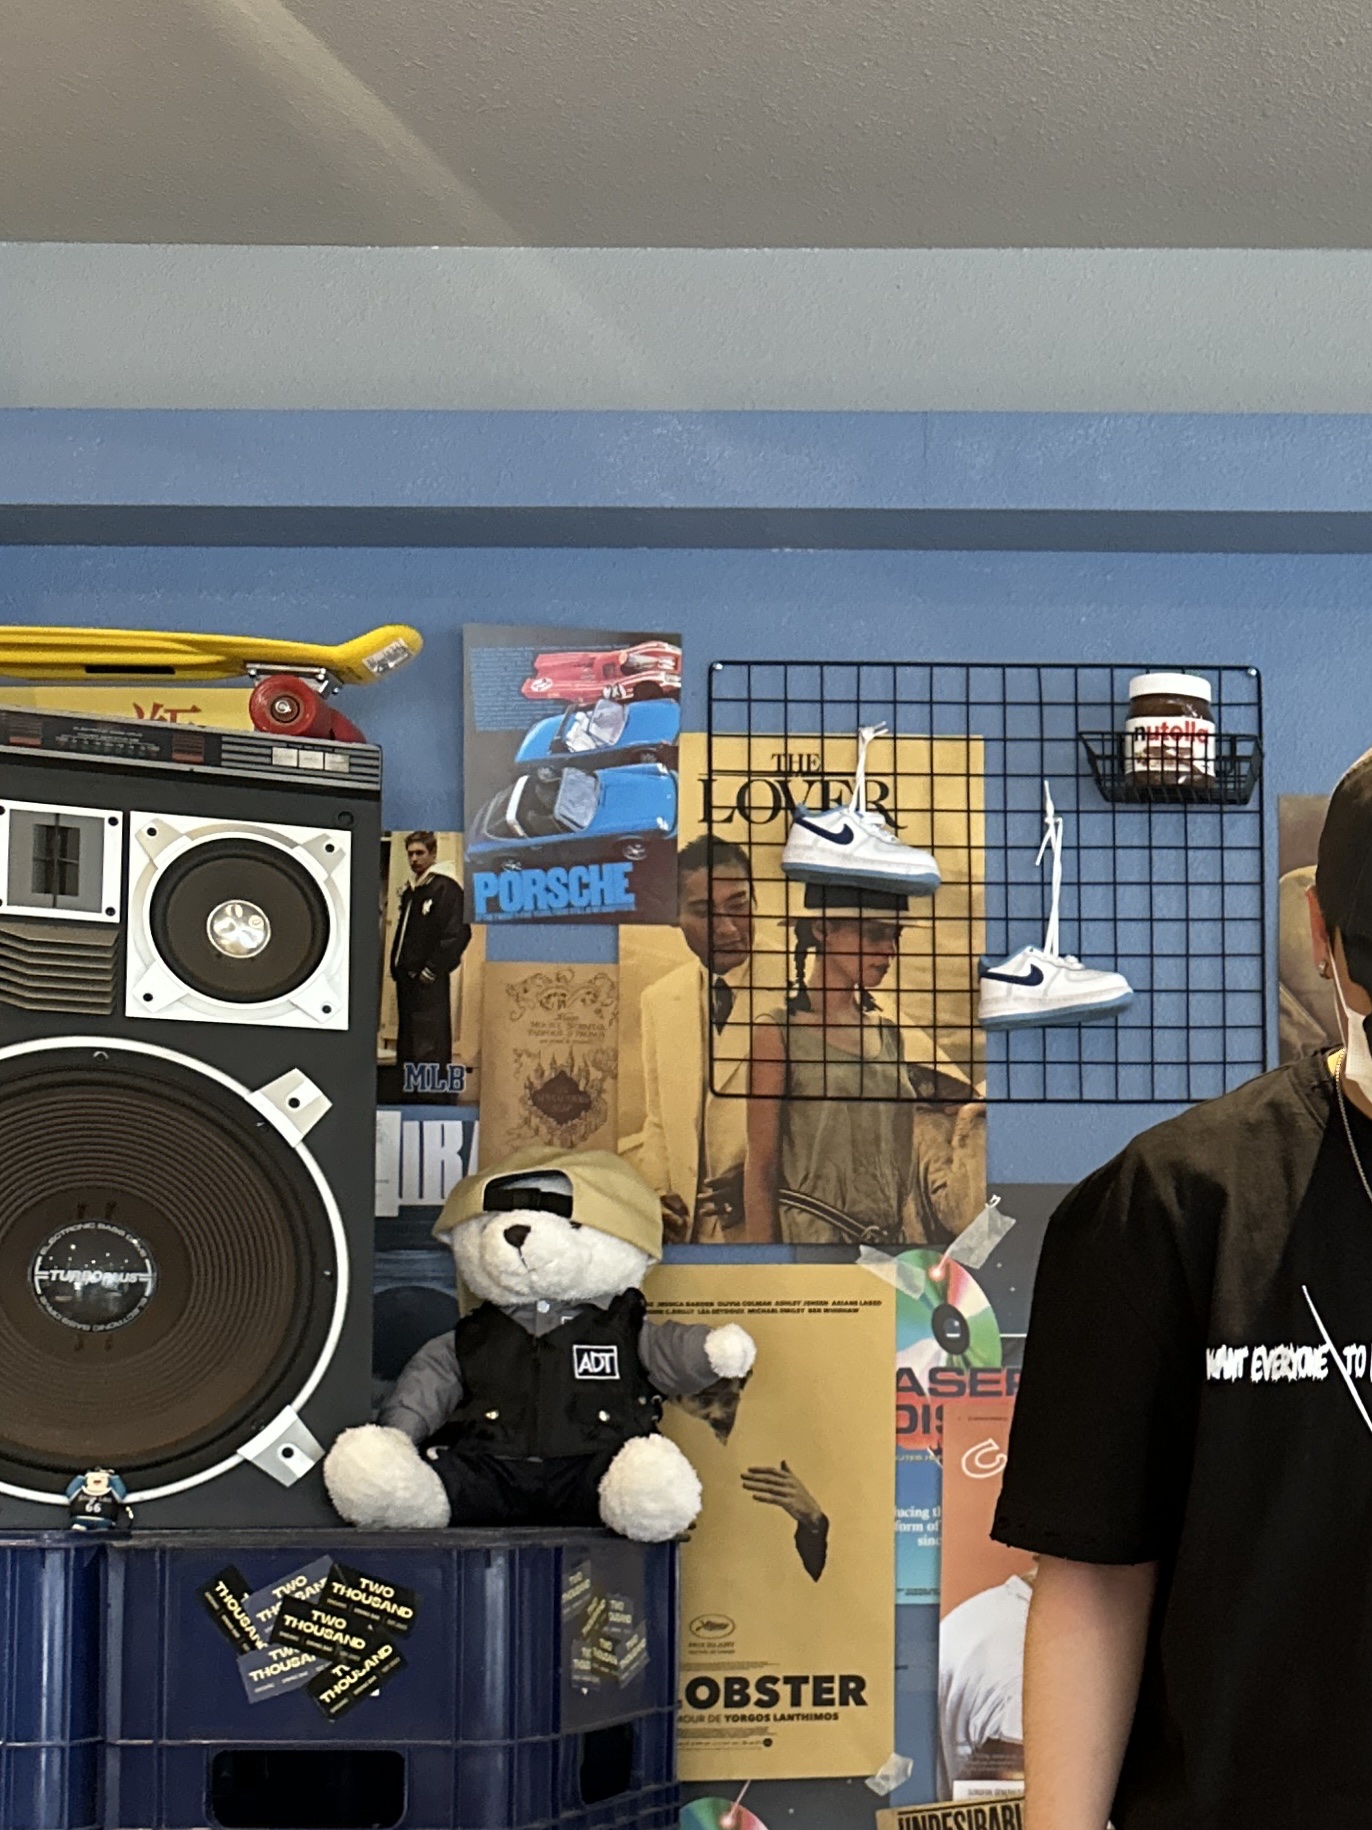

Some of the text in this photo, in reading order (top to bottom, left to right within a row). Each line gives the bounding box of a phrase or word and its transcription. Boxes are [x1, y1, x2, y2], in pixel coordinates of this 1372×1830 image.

[1135, 721, 1208, 743] nutella
[771, 753, 822, 773] THE
[473, 862, 635, 915] PORSCHE
[403, 1062, 467, 1093] MLB
[577, 1350, 616, 1375] ADT
[1251, 1342, 1329, 1383] EVERYONE
[1343, 1343, 1366, 1379] TO
[331, 1582, 413, 1619] THOUSAND
[360, 1577, 395, 1598] TWO
[283, 1614, 366, 1650] THOUSAND
[311, 1609, 347, 1630] TWO
[676, 1675, 868, 1709] OBSTER
[724, 1713, 770, 1722] YORGOS
[773, 1712, 839, 1721] LANTHIMOS
